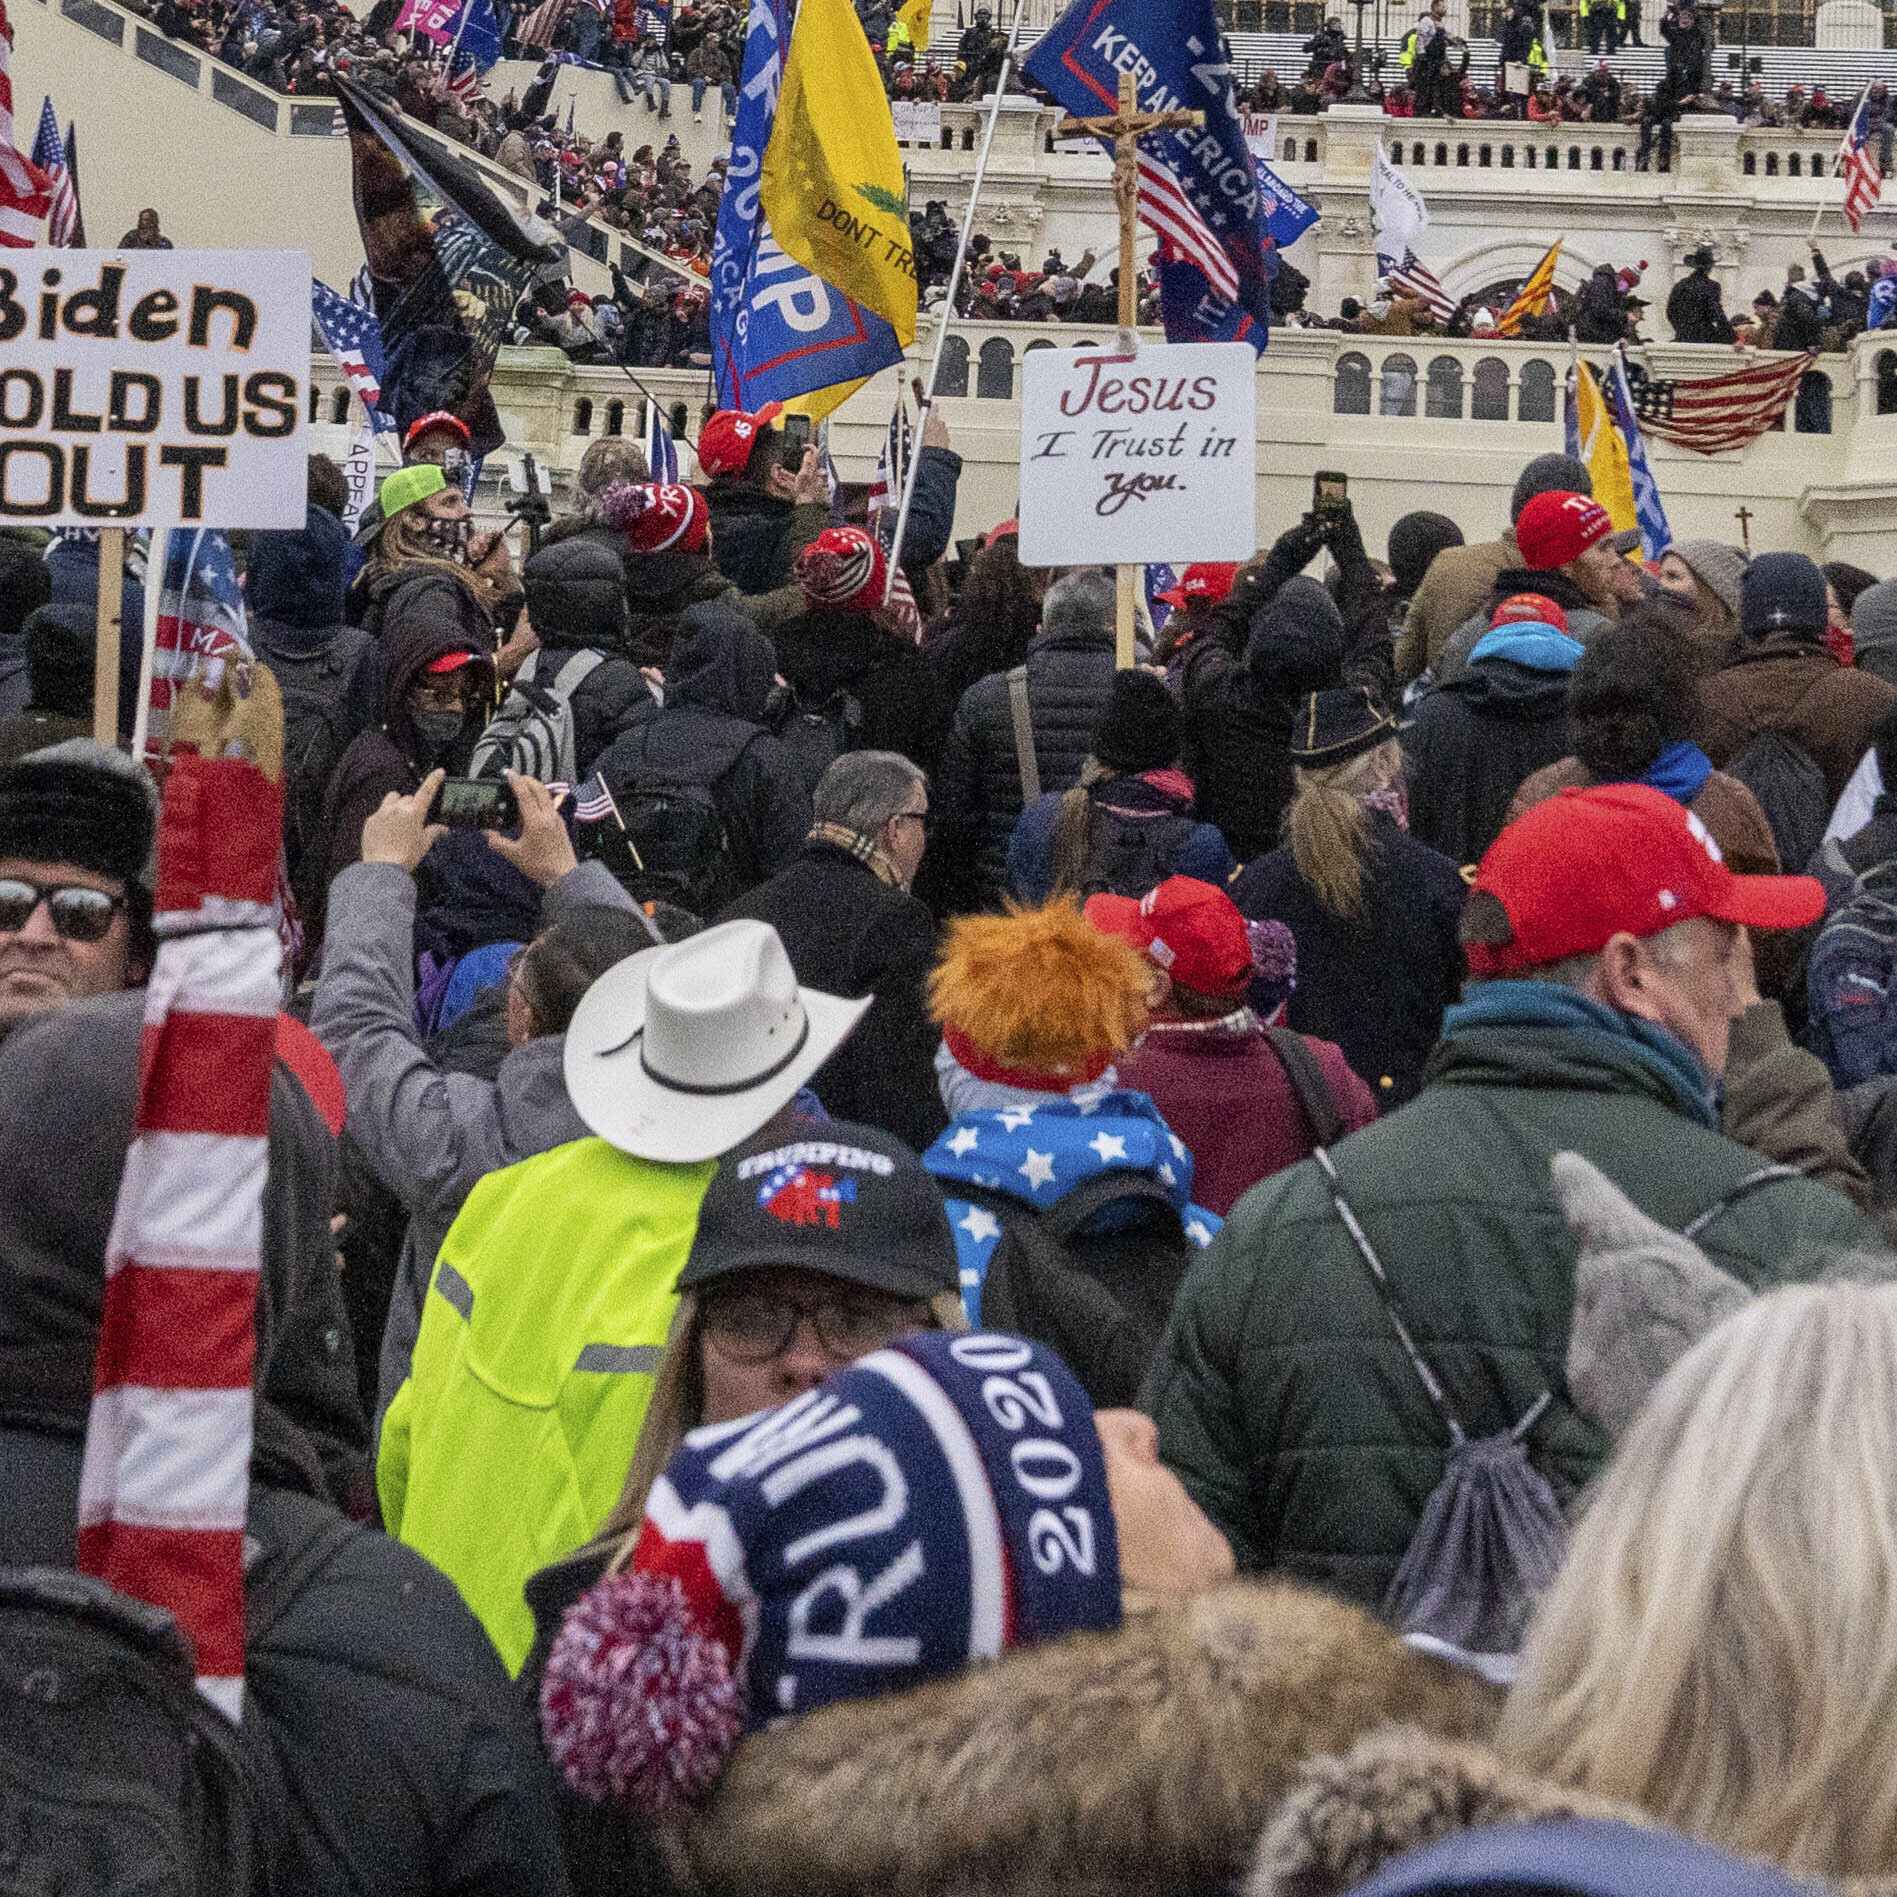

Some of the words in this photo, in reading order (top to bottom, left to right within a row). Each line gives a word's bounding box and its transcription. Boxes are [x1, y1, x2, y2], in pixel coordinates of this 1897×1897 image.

[1092, 25, 1157, 92] KEEP
[1240, 119, 1269, 137] UMP
[816, 198, 882, 252] DONT
[888, 239, 918, 279] TRE
[183, 370, 299, 438] US
[1060, 354, 1217, 417] Jesus
[1030, 431, 1076, 461] I
[1092, 422, 1188, 459] Trust
[1200, 427, 1237, 457] in
[951, 1334, 1095, 1576] 2020
[684, 1388, 924, 1710] RUM
